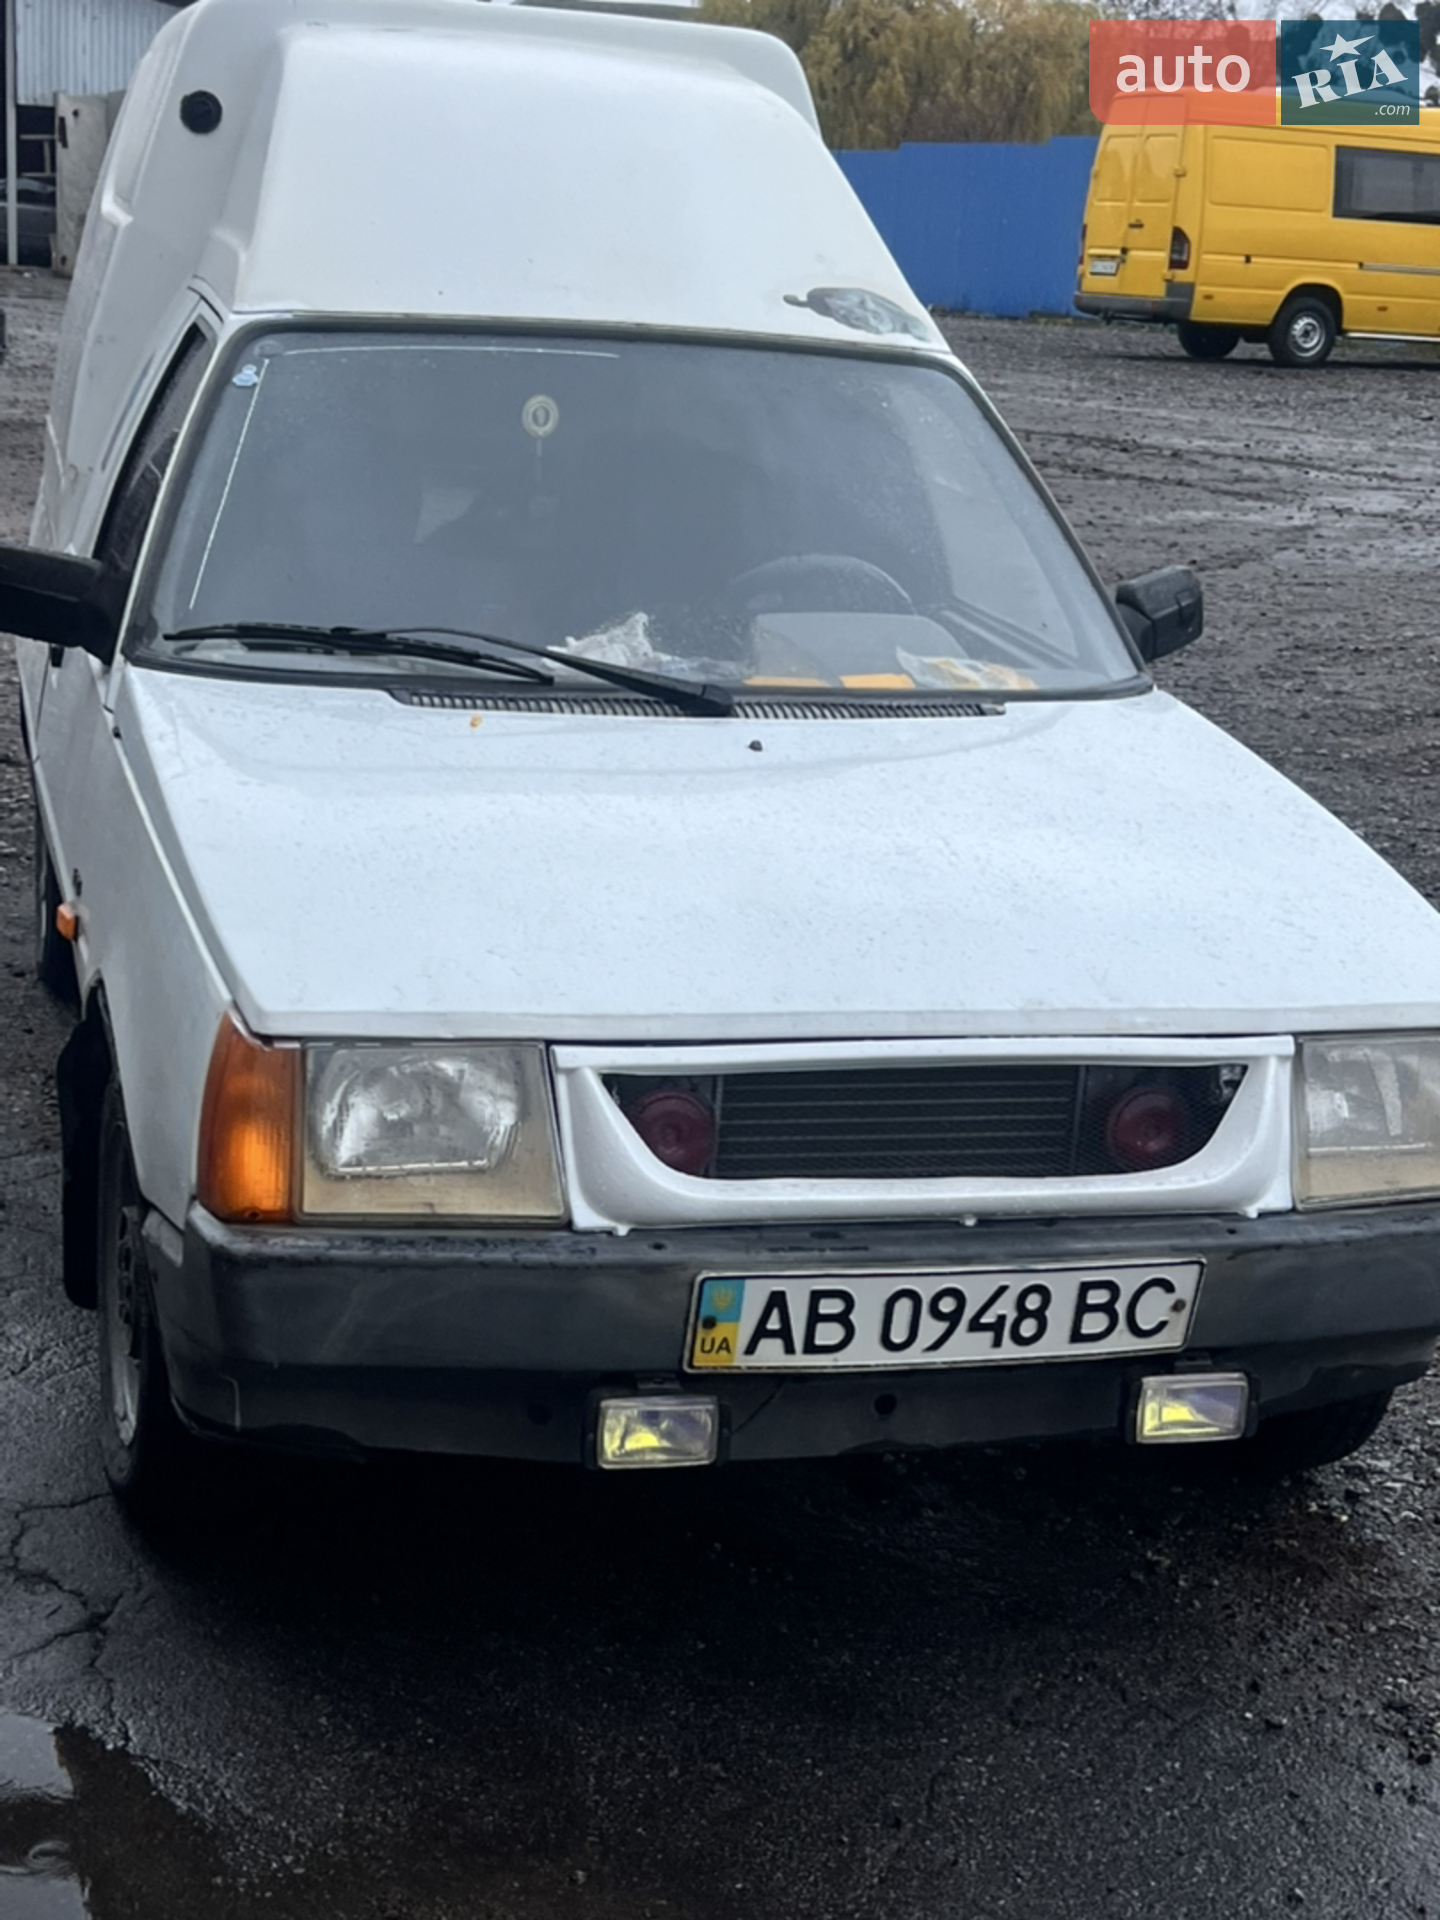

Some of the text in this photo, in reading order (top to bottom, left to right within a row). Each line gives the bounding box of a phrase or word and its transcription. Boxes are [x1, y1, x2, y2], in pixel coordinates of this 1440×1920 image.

[743, 1277, 1176, 1356] AB 0948 BC
[700, 1337, 732, 1355] UA
